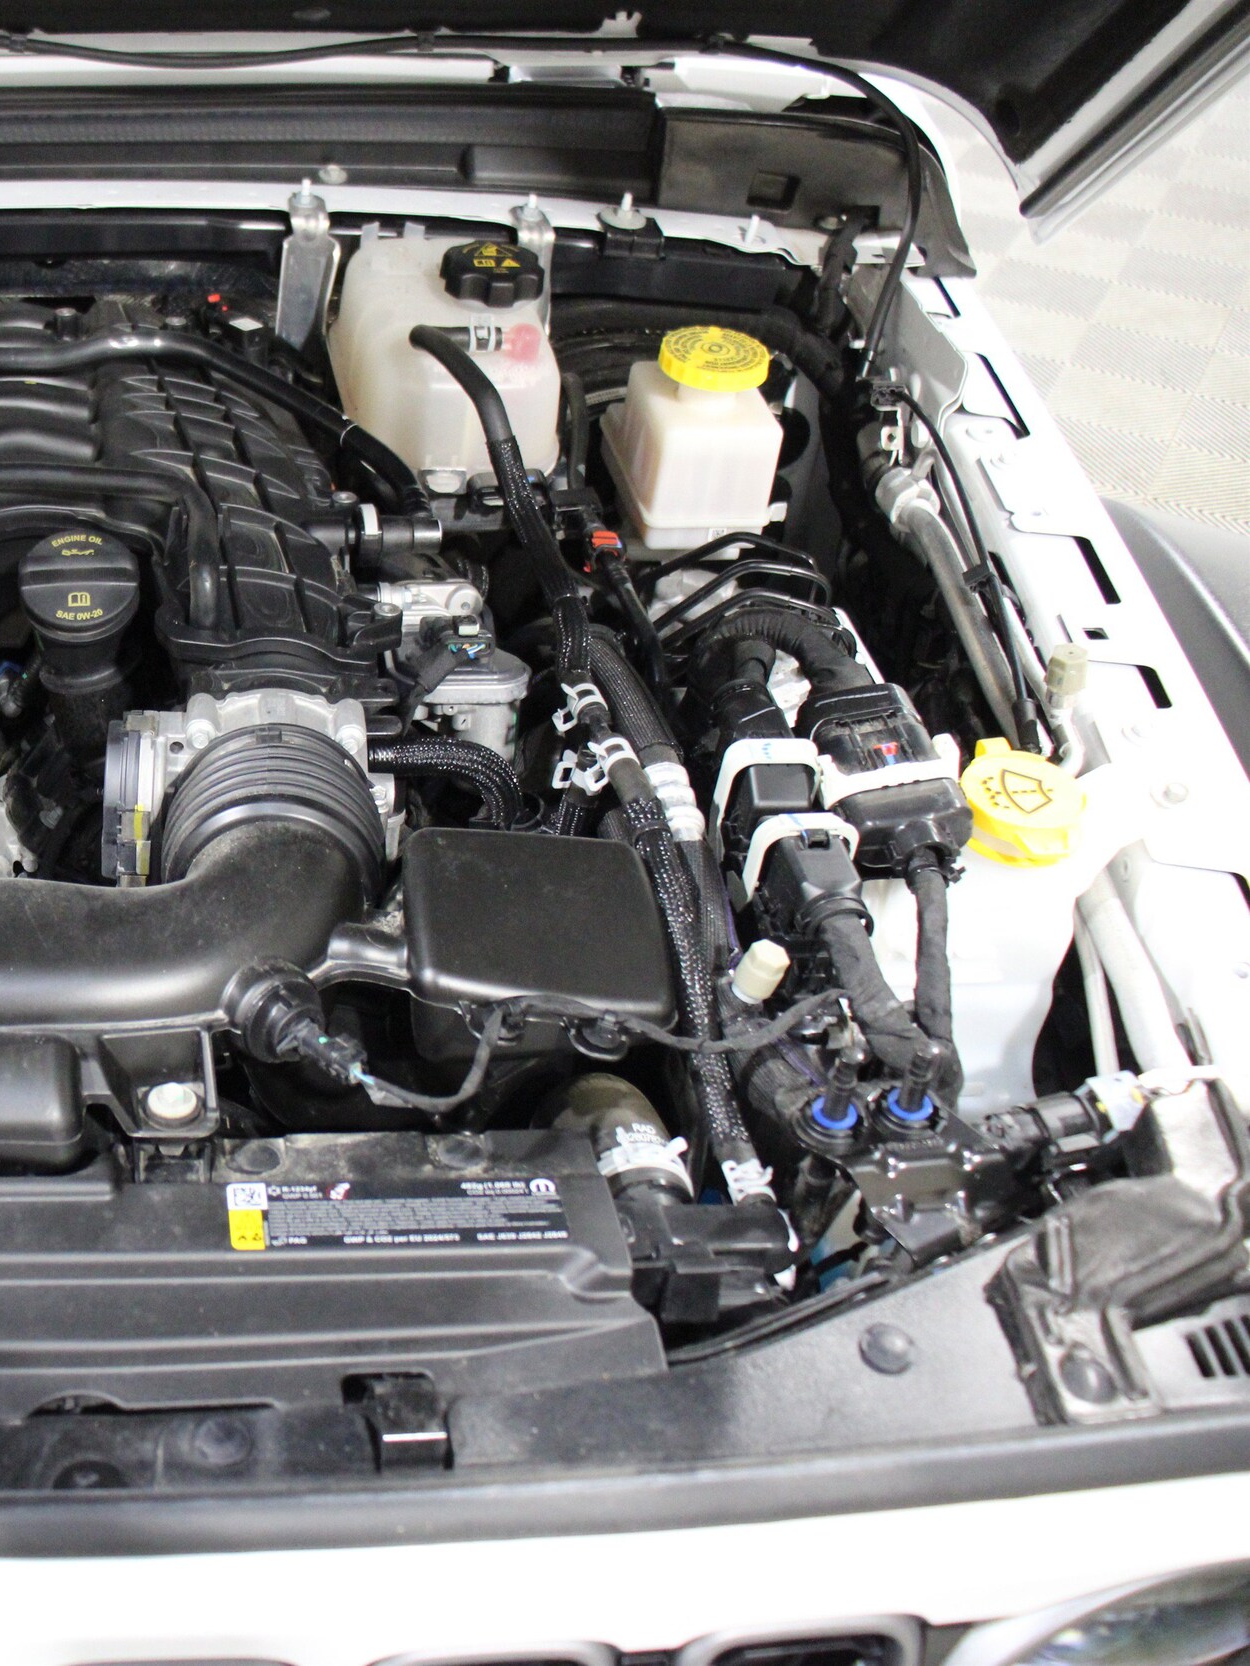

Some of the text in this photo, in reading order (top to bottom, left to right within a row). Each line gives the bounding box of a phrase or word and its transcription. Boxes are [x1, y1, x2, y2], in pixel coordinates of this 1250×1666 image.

[52, 534, 103, 547] ENGINE OIL
[56, 608, 103, 620] SAE 0W-20
[631, 1123, 656, 1134] RAD
